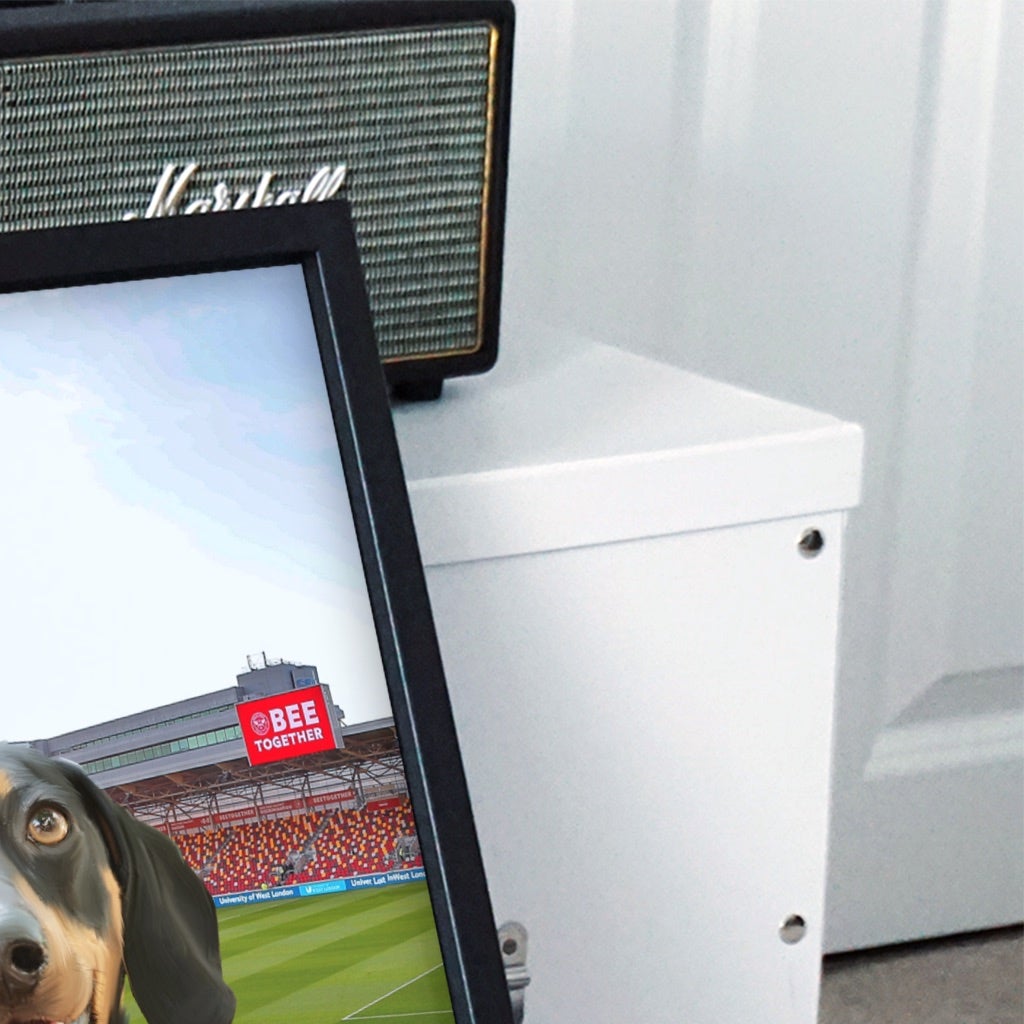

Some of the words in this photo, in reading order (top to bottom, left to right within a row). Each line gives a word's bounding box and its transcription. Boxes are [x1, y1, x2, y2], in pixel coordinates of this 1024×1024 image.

[123, 163, 347, 220] Marshall
[268, 700, 320, 733] BEE
[254, 727, 324, 753] TOGETHER
[248, 893, 255, 901] of
[256, 890, 271, 899] West
[271, 889, 294, 898] London
